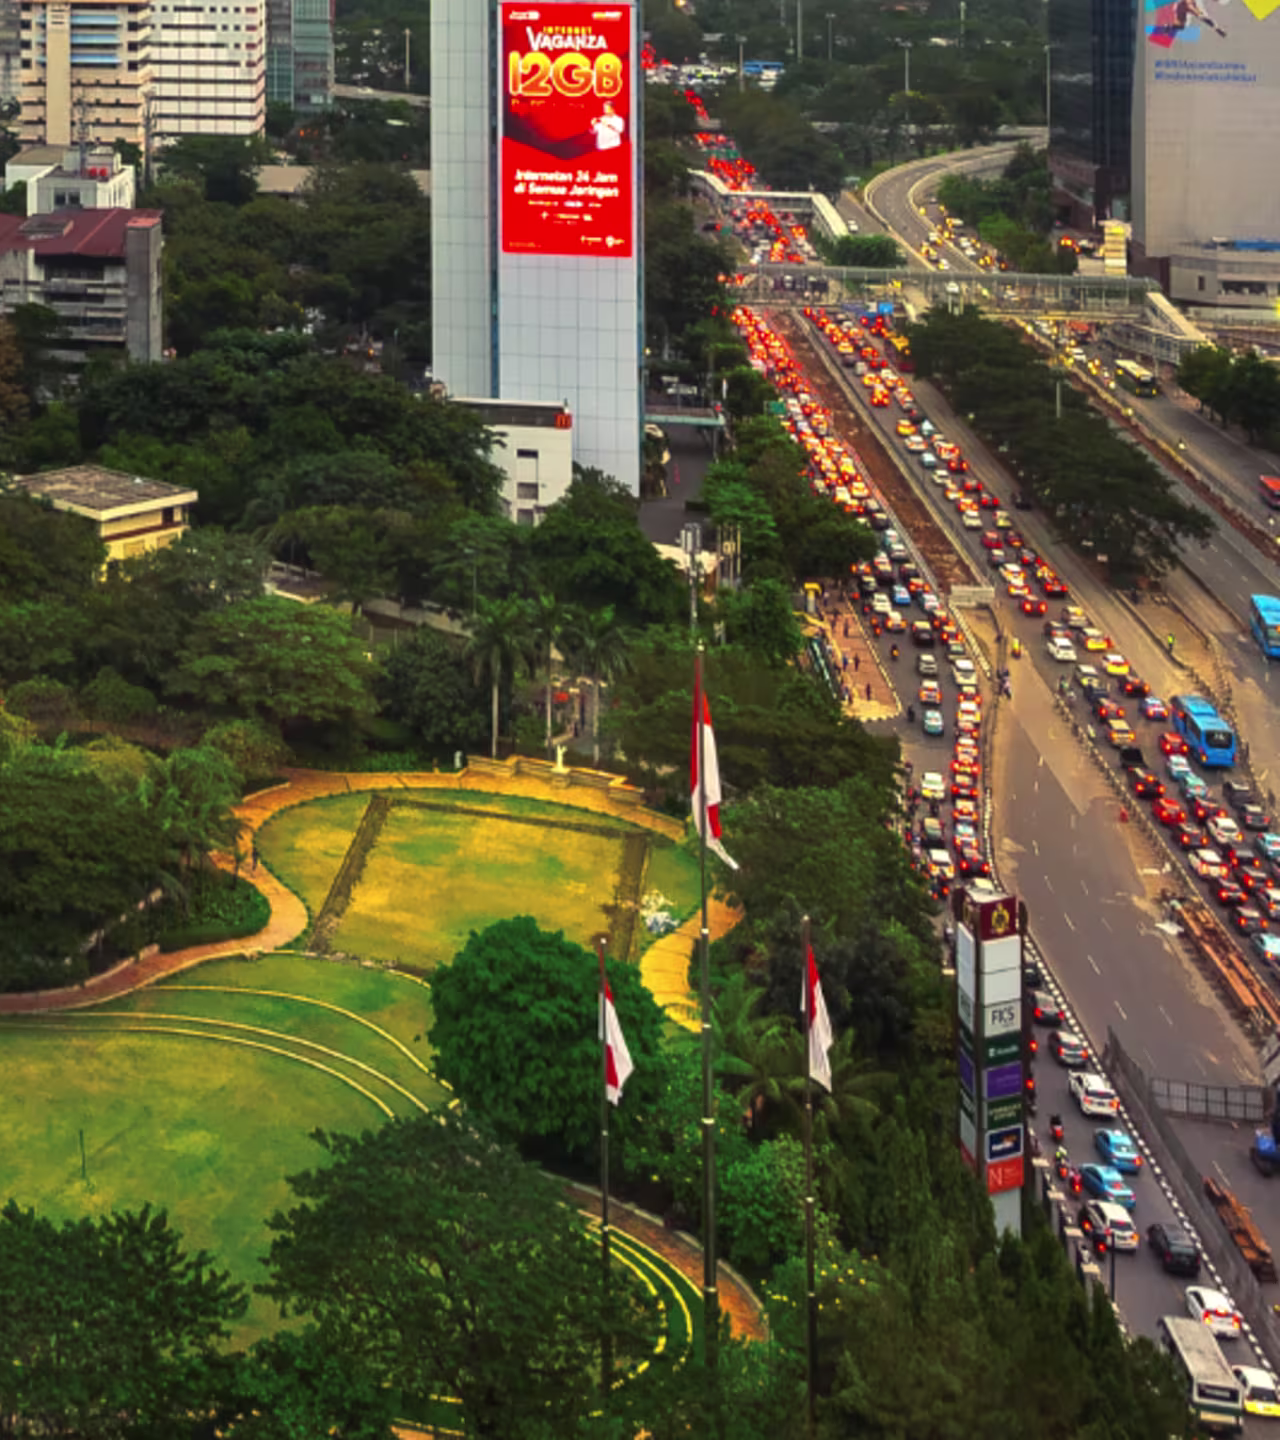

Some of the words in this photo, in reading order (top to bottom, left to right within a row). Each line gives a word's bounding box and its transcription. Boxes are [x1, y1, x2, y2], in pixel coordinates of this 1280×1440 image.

[525, 25, 609, 52] VAGANZA
[508, 50, 624, 99] 12GB
[991, 1006, 1015, 1026] FKS
